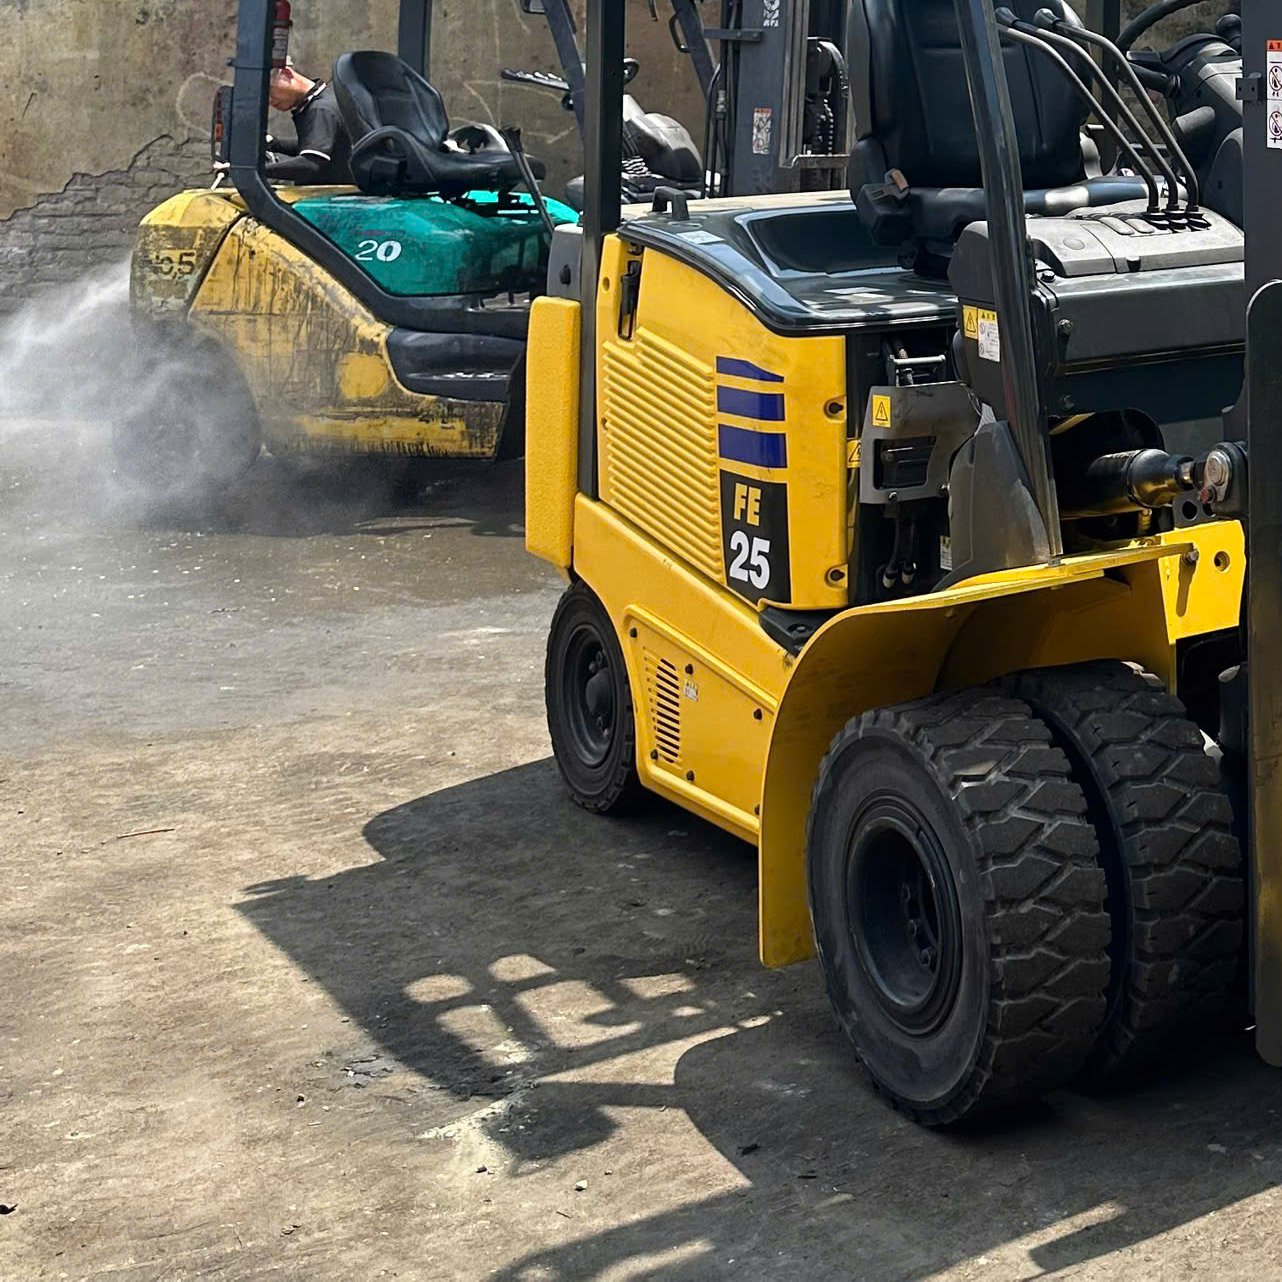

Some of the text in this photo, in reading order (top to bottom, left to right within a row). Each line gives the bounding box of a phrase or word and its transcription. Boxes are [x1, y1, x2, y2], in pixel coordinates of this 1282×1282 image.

[354, 239, 402, 262] 20
[733, 482, 762, 527] FE
[729, 530, 770, 590] 25
